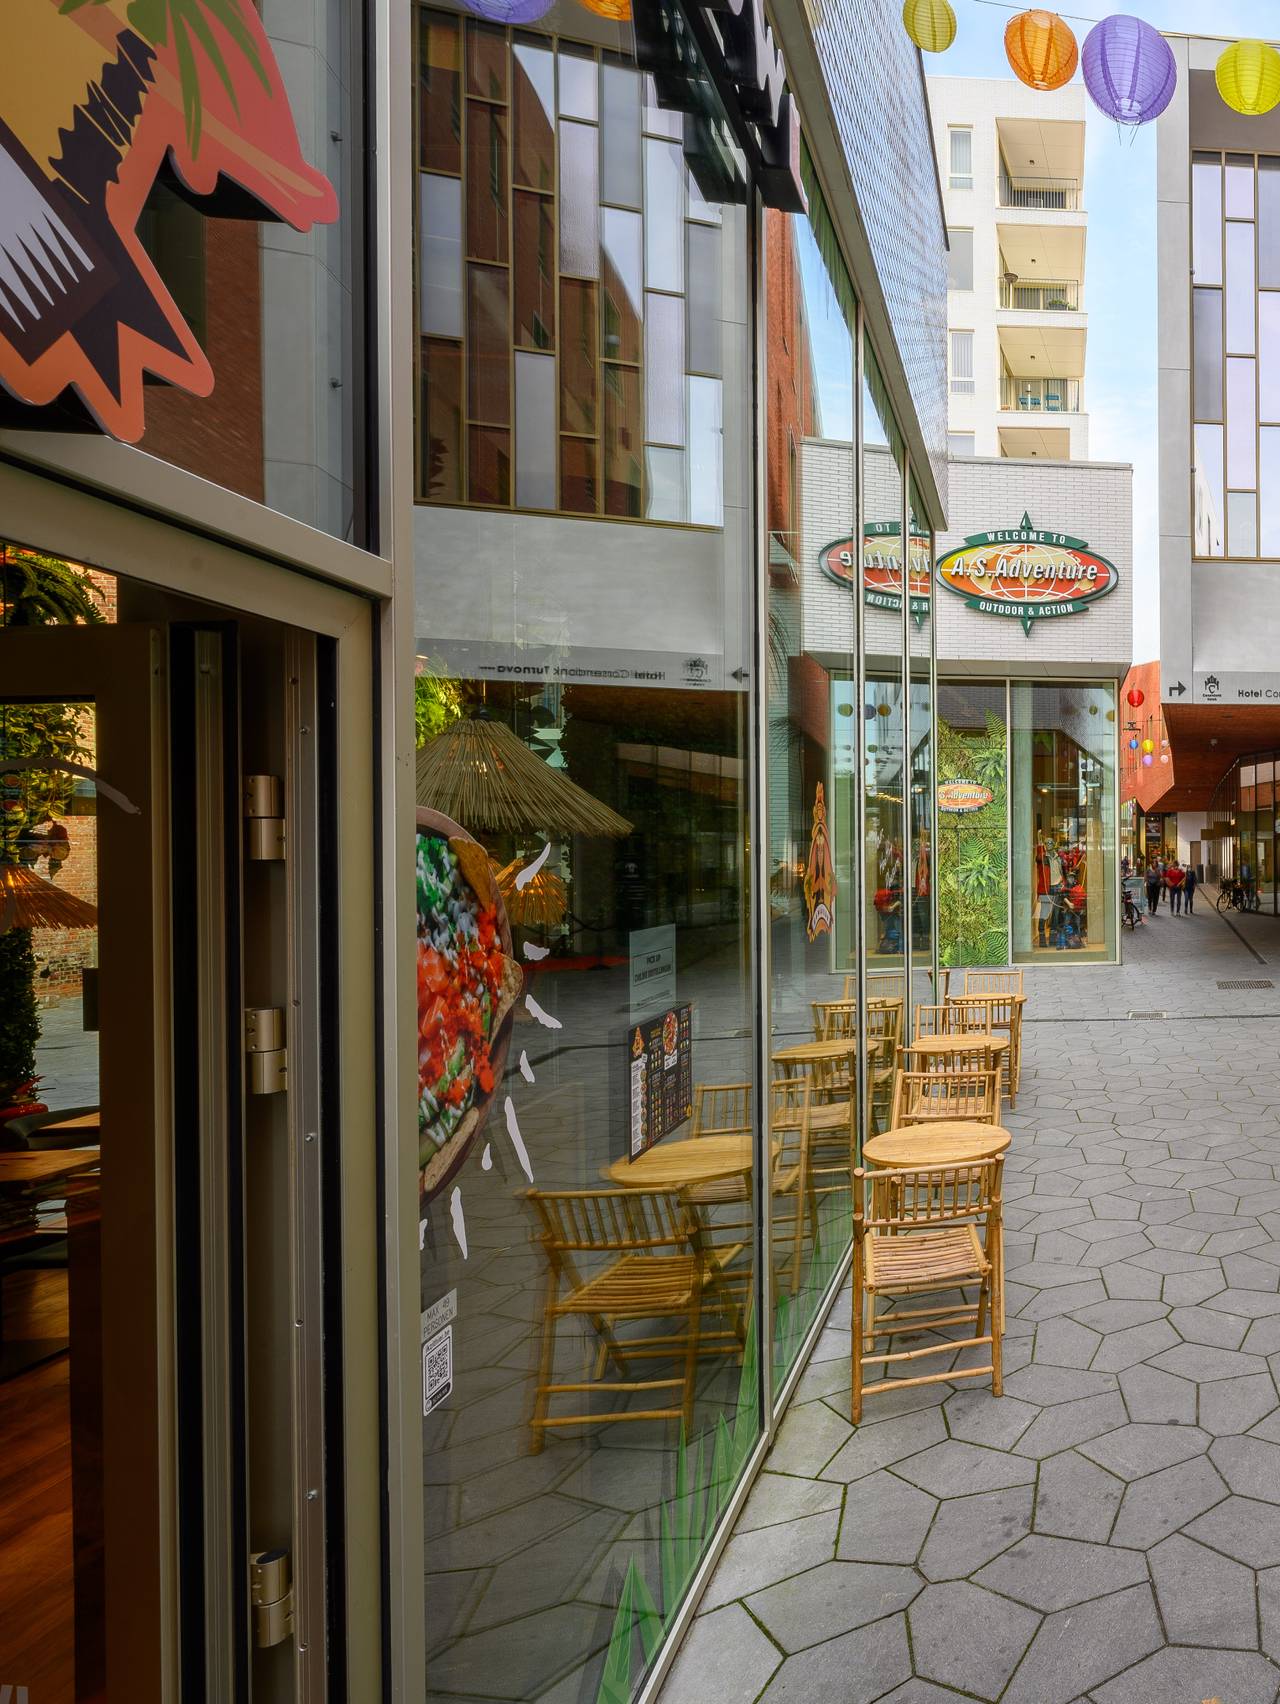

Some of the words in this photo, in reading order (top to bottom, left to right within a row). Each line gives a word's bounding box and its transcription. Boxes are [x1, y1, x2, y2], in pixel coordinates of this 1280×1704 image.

[986, 530, 1045, 542] WELCOME
[1052, 531, 1067, 544] TO
[979, 601, 1024, 616] OUTDOOR
[1027, 607, 1035, 616] &
[1038, 603, 1074, 616] ACTION
[1237, 689, 1263, 698] Hotel
[426, 1306, 439, 1321] MAX
[423, 1308, 454, 1338] PERSONEN
